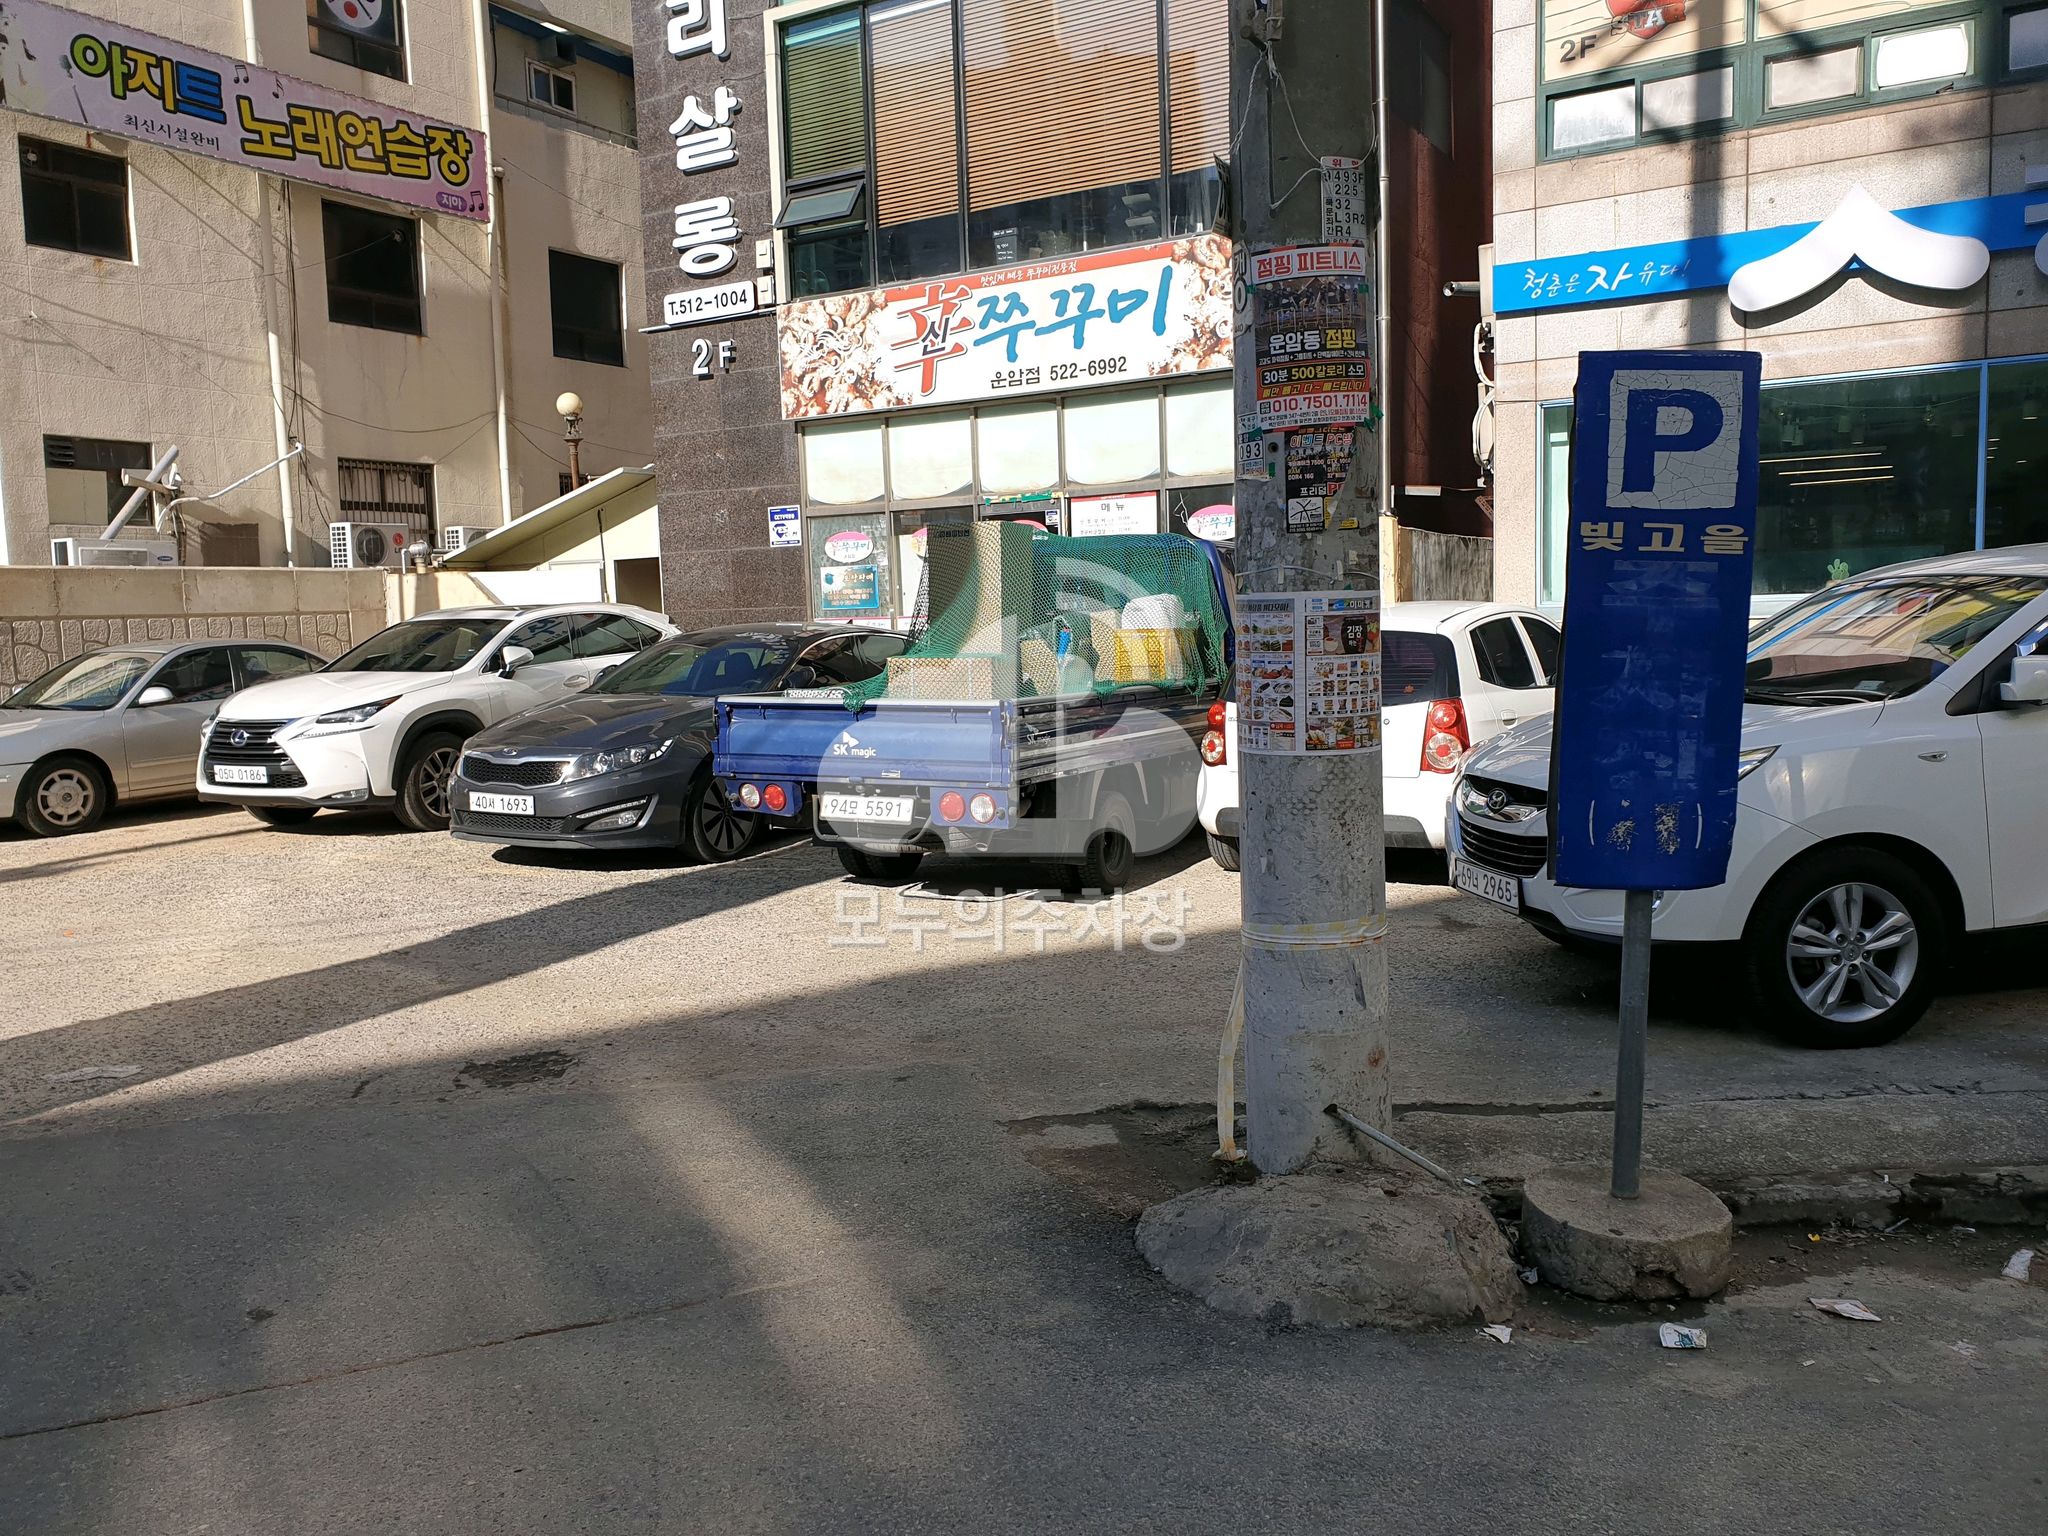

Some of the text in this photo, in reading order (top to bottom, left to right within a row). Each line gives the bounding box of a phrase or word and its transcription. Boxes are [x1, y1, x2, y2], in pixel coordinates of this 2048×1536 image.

[1560, 34, 1597, 63] 2F
[70, 33, 473, 186] 아지트 노래연습장
[124, 114, 220, 151] 최신시설완비
[1257, 250, 1363, 279] 점핑 피트니스
[1523, 258, 1692, 299] 청춘은 자유다!
[980, 273, 1005, 287] 맛있게
[668, 288, 748, 316] T.512-1004
[921, 316, 951, 357] 신
[973, 265, 1173, 363] 쭈꾸미
[1269, 328, 1356, 355] 운암동 점핑
[990, 355, 1128, 389] 운암점 522-6992
[1263, 364, 1365, 384] 30분 500칼로리 소모
[1272, 394, 1368, 413] 010.7501.7114
[1621, 388, 1723, 494] P
[1346, 625, 1363, 639] 김장
[833, 743, 877, 758] SK magic
[237, 768, 262, 781] 0186
[500, 797, 528, 812] 1693
[830, 798, 902, 818] 94모 5591
[1483, 873, 1512, 902] 2965
